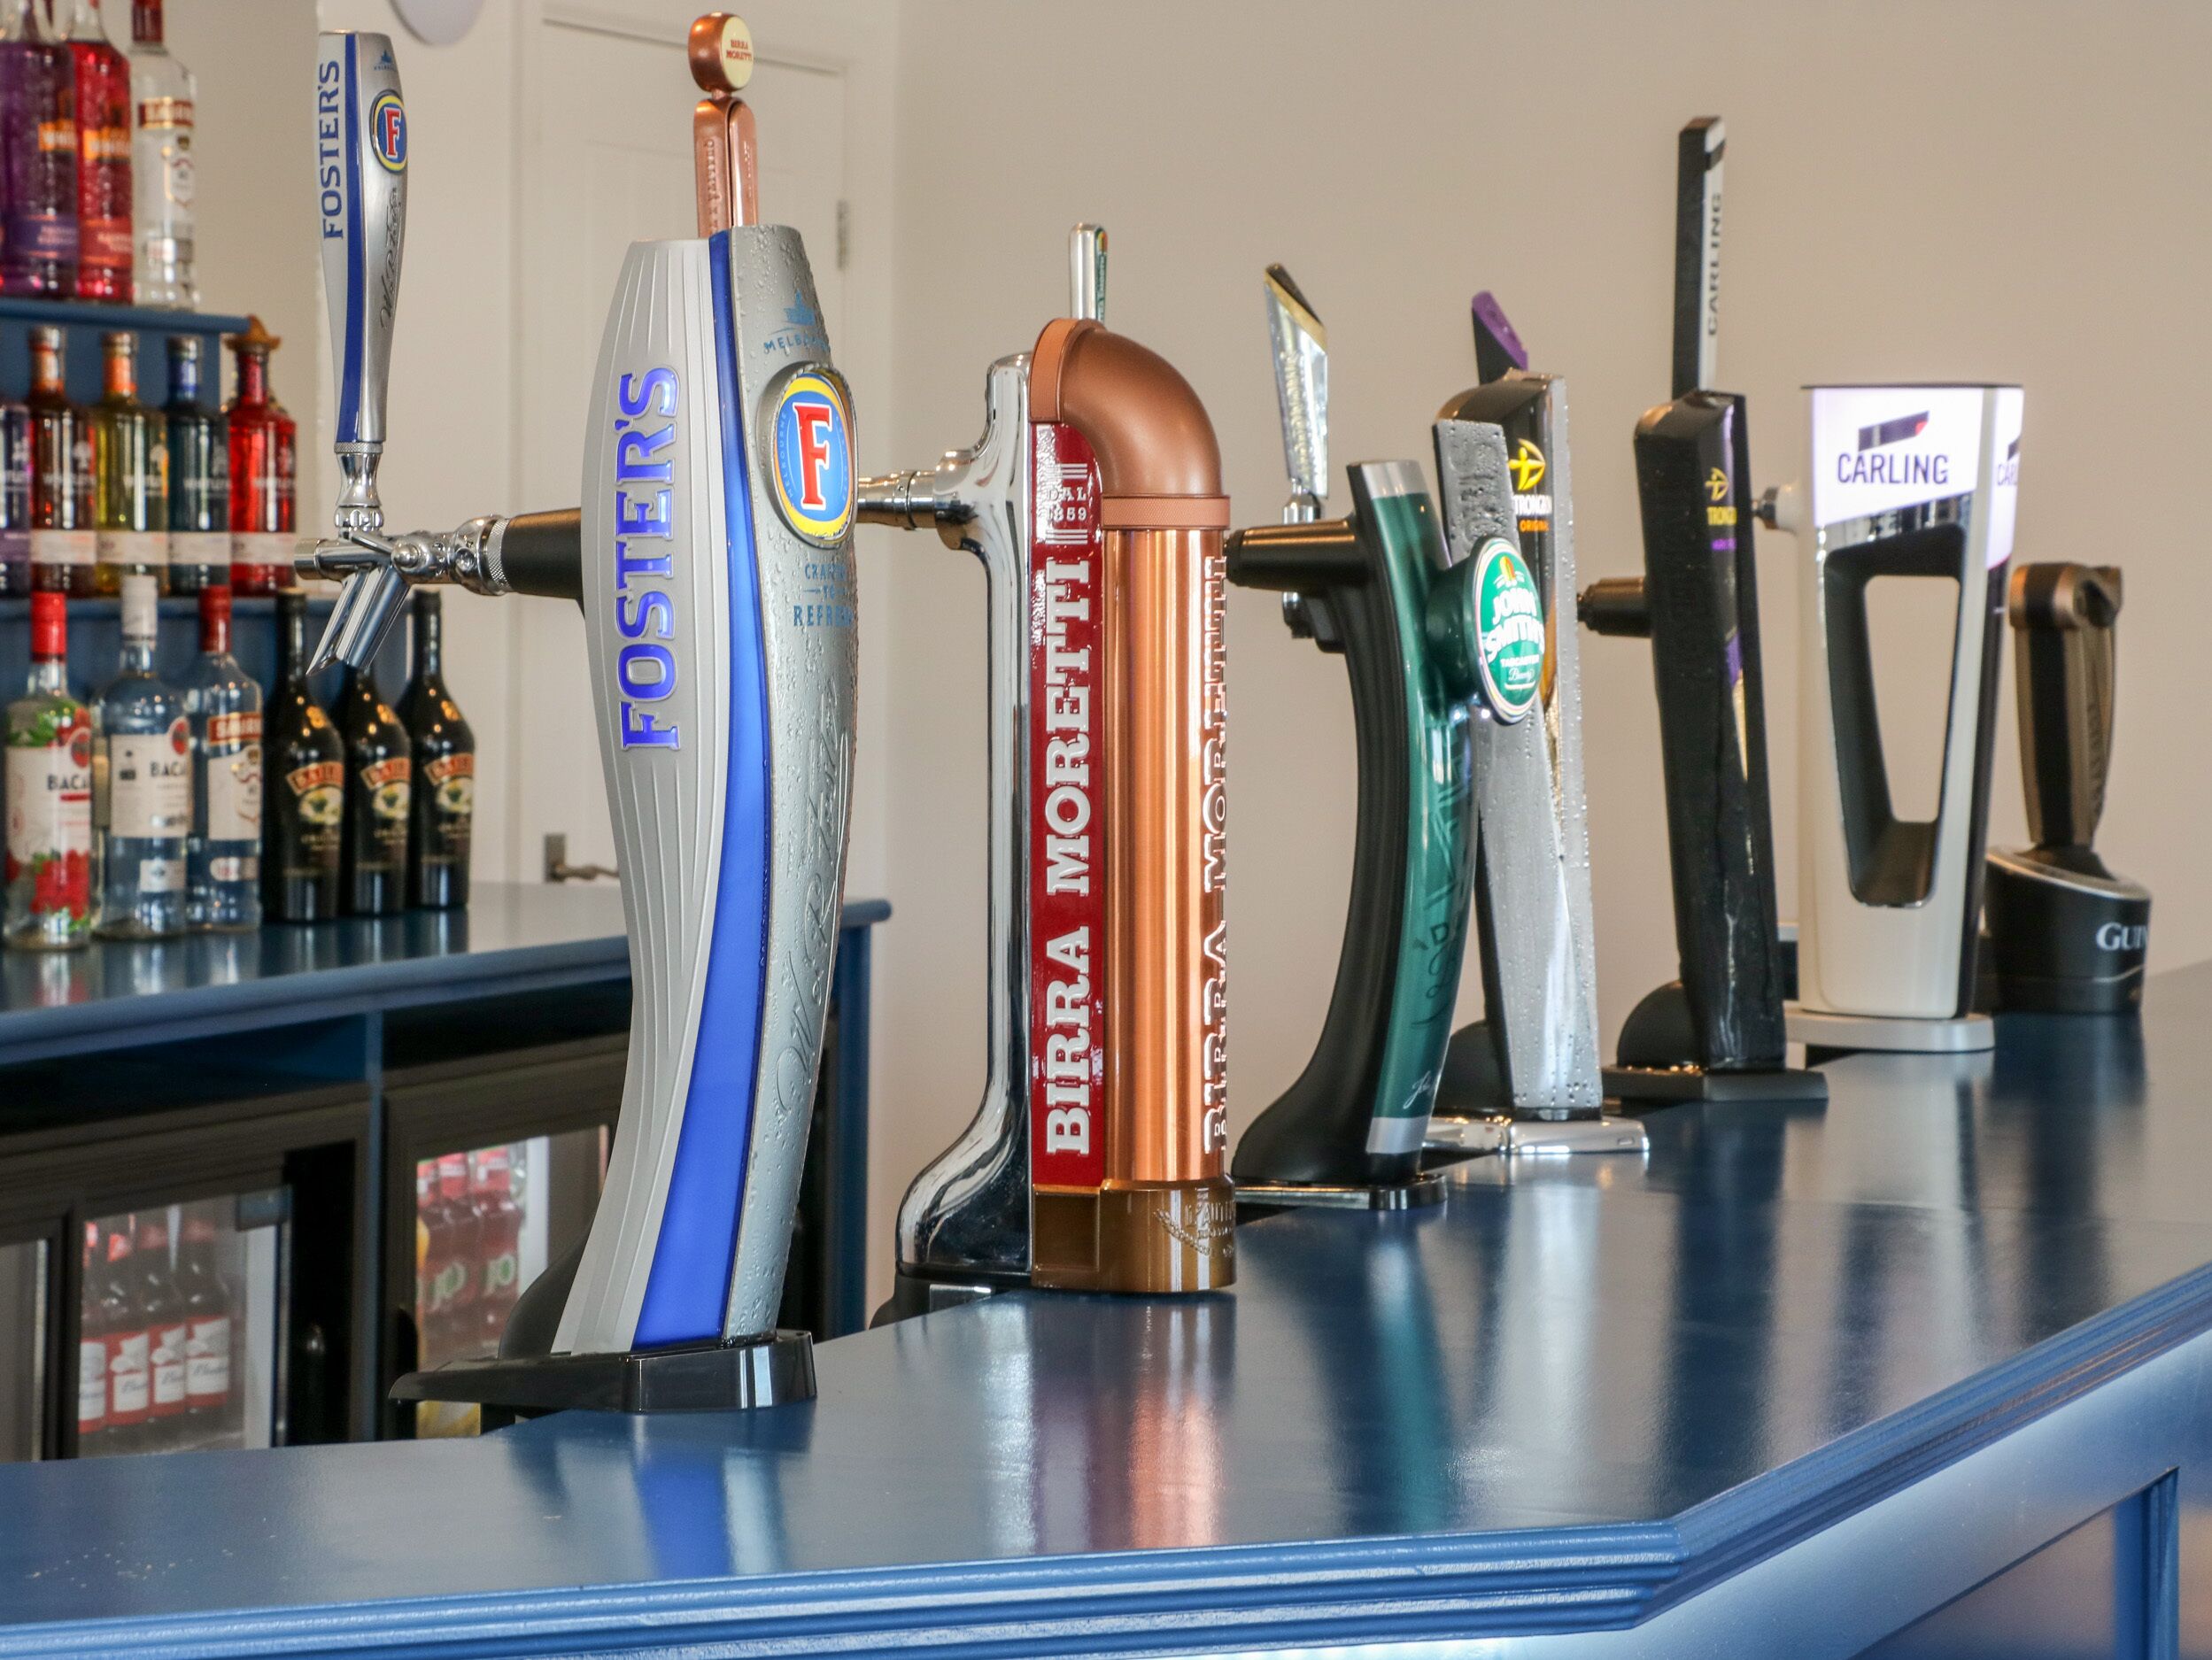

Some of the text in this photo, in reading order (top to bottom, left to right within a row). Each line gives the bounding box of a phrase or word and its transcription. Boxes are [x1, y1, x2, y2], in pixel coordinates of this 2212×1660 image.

[317, 60, 344, 240] FOSTER'S
[384, 106, 402, 158] F
[793, 402, 832, 511] F
[1047, 486, 1087, 502] DAL
[1837, 452, 1949, 485] CARLING
[614, 364, 682, 752] FOSTER'S
[1492, 587, 1536, 625] JOHN
[1044, 556, 1091, 1156] BIRRA MORETTI
